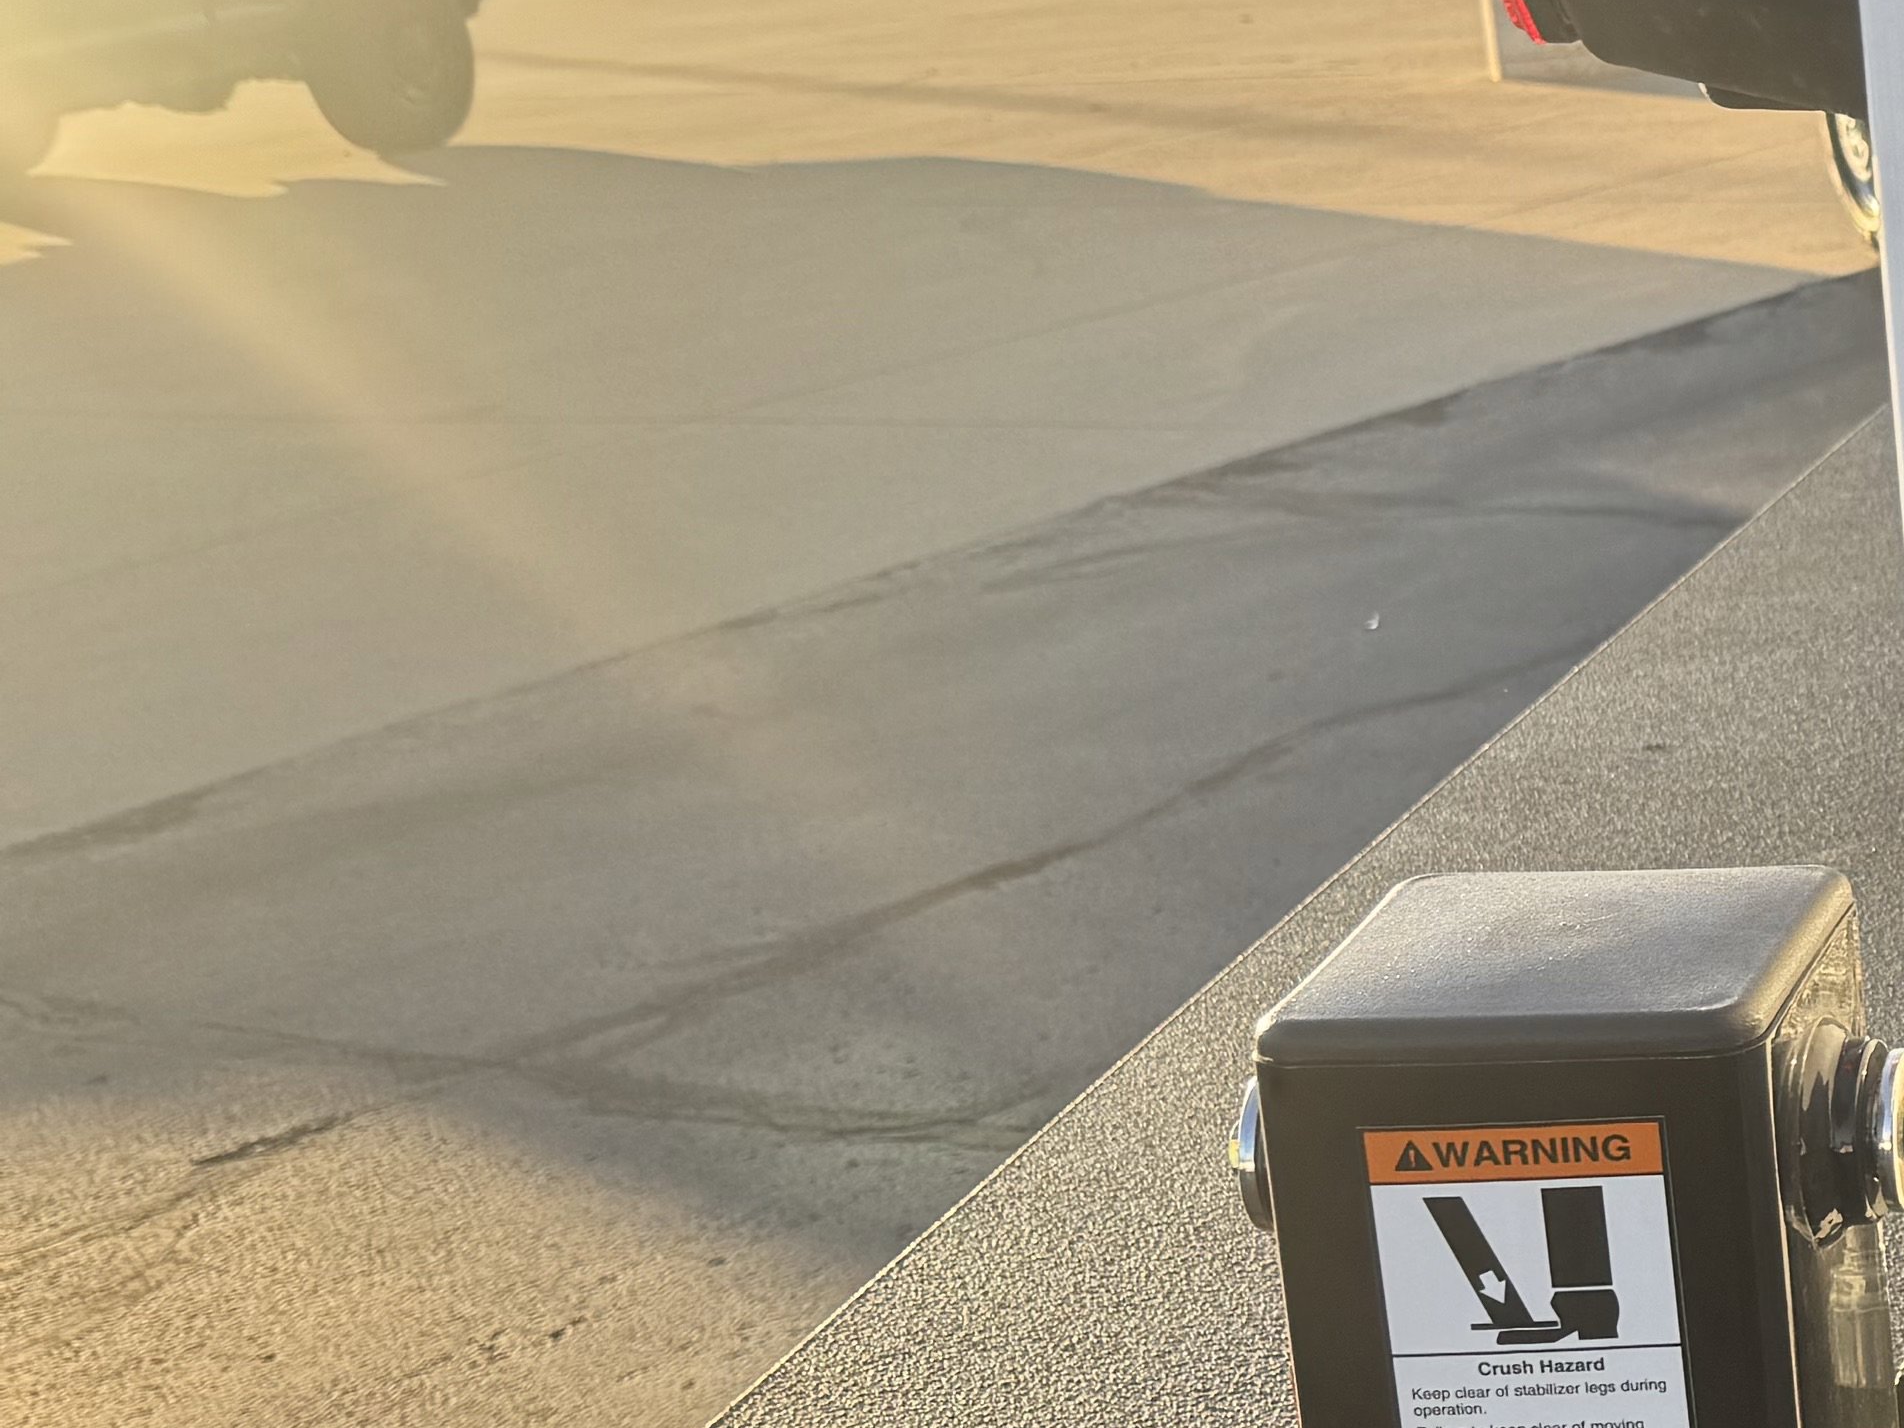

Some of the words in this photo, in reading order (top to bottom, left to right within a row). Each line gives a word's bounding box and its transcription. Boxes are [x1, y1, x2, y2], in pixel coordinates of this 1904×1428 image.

[1431, 1134, 1632, 1168] WARNING
[1477, 1360, 1533, 1376] Crush
[1539, 1356, 1604, 1373] Hazard
[1411, 1387, 1450, 1401] Keep
[1454, 1386, 1490, 1398] clear
[1495, 1384, 1508, 1397] of
[1513, 1383, 1580, 1396] stabilizer
[1584, 1381, 1615, 1396] legs
[1620, 1378, 1666, 1393] during
[1413, 1401, 1487, 1418] operation.
